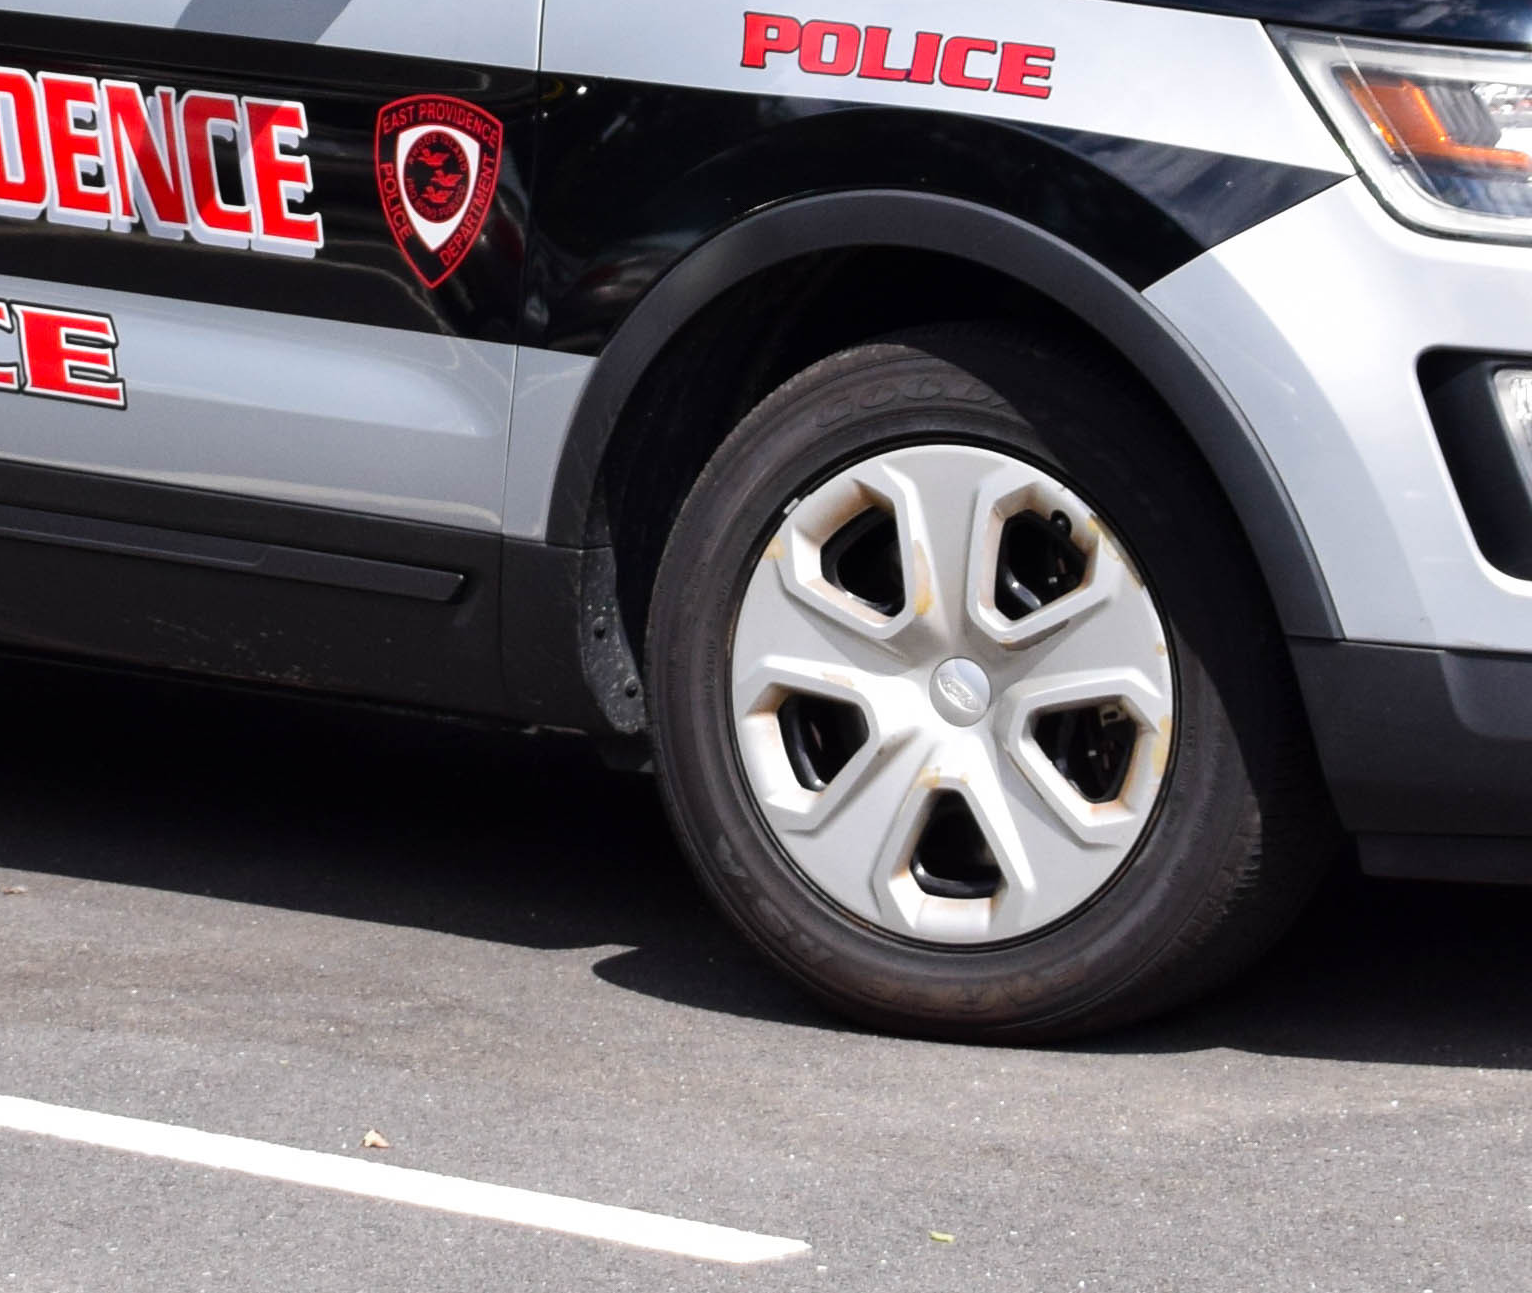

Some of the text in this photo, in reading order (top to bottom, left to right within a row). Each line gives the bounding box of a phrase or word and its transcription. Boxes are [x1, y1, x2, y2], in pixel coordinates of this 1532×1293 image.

[741, 11, 1056, 99] POLICE
[382, 102, 499, 148] EAST PROVIDENCE
[379, 162, 415, 242] POLICE
[438, 151, 496, 267] DEPARTMENT
